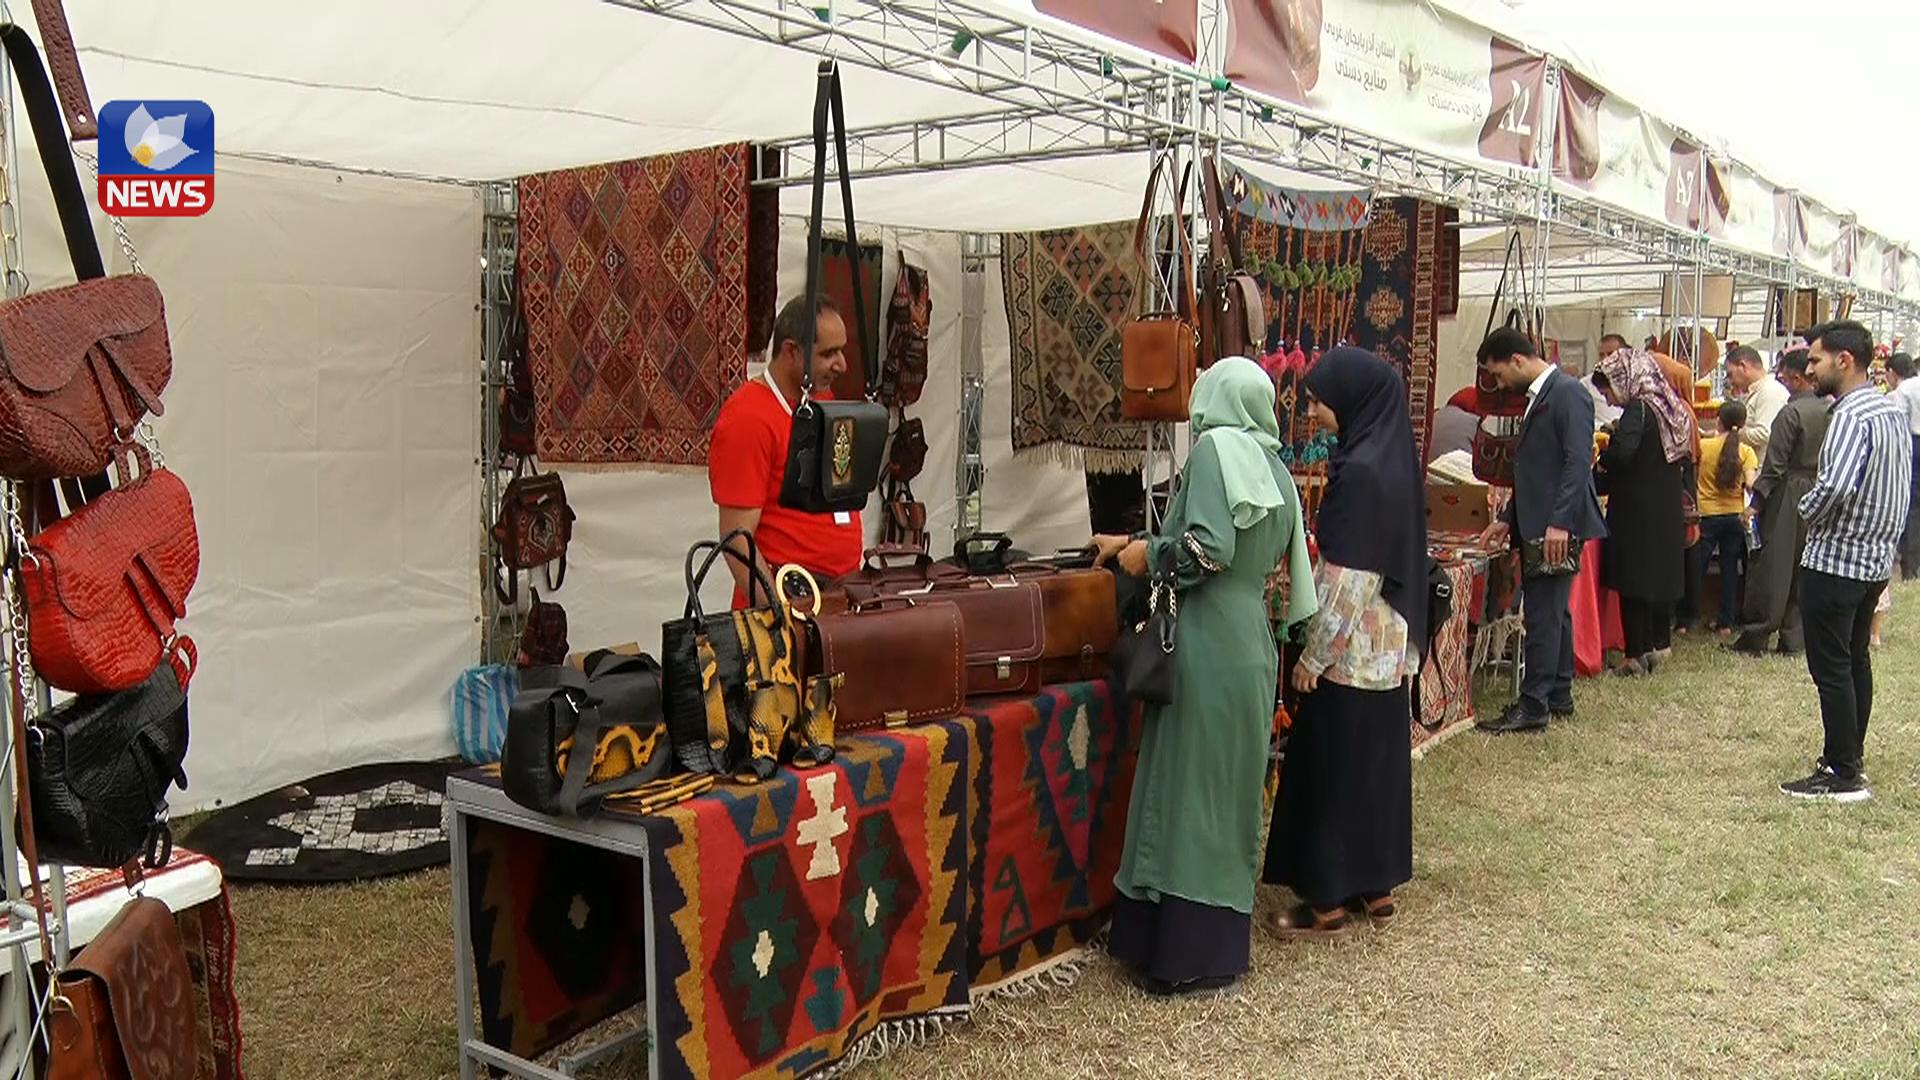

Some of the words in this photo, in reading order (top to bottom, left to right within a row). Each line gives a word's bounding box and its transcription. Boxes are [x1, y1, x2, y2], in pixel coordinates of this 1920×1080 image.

[1323, 21, 1343, 42] غربی
[1375, 40, 1396, 60] استان
[1334, 59, 1362, 82] دستی
[1363, 68, 1388, 92] صنایع
